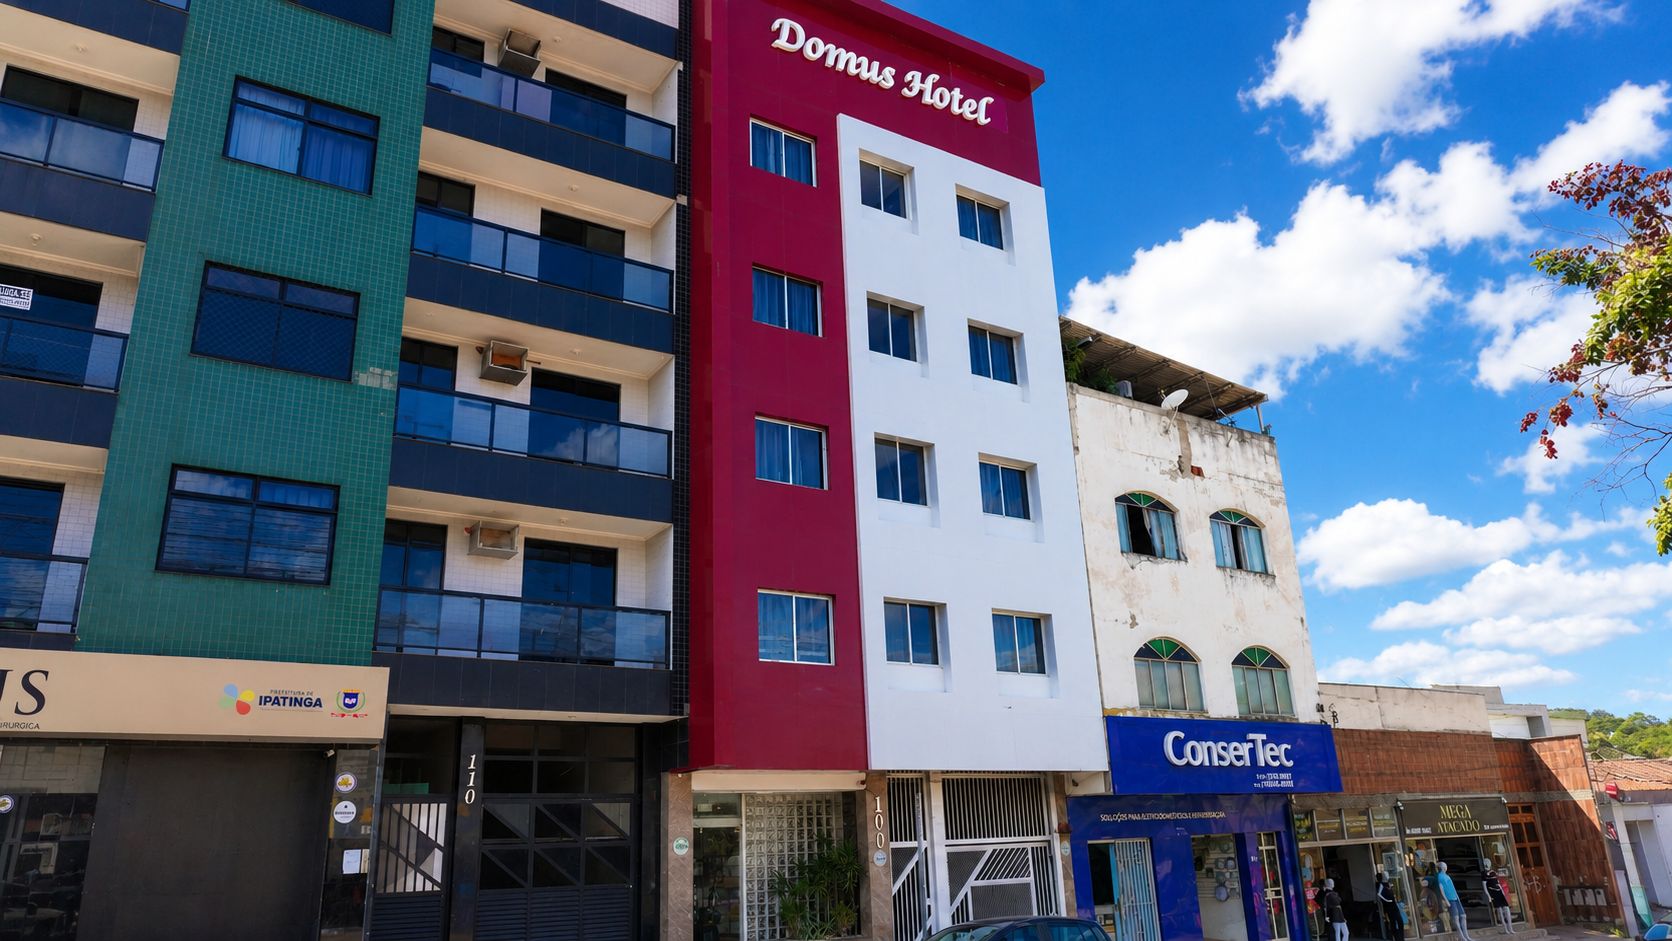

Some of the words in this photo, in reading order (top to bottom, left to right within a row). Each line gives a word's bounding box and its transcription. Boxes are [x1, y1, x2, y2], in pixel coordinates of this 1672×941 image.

[771, 18, 896, 89] Domus
[901, 71, 994, 126] Hotel
[258, 695, 323, 708] IPATINGA
[1163, 730, 1294, 768] ConserTec
[465, 754, 476, 805] 110
[875, 796, 885, 849] 100
[1438, 819, 1480, 833] ATACADO
[1440, 804, 1471, 819] MEGA
